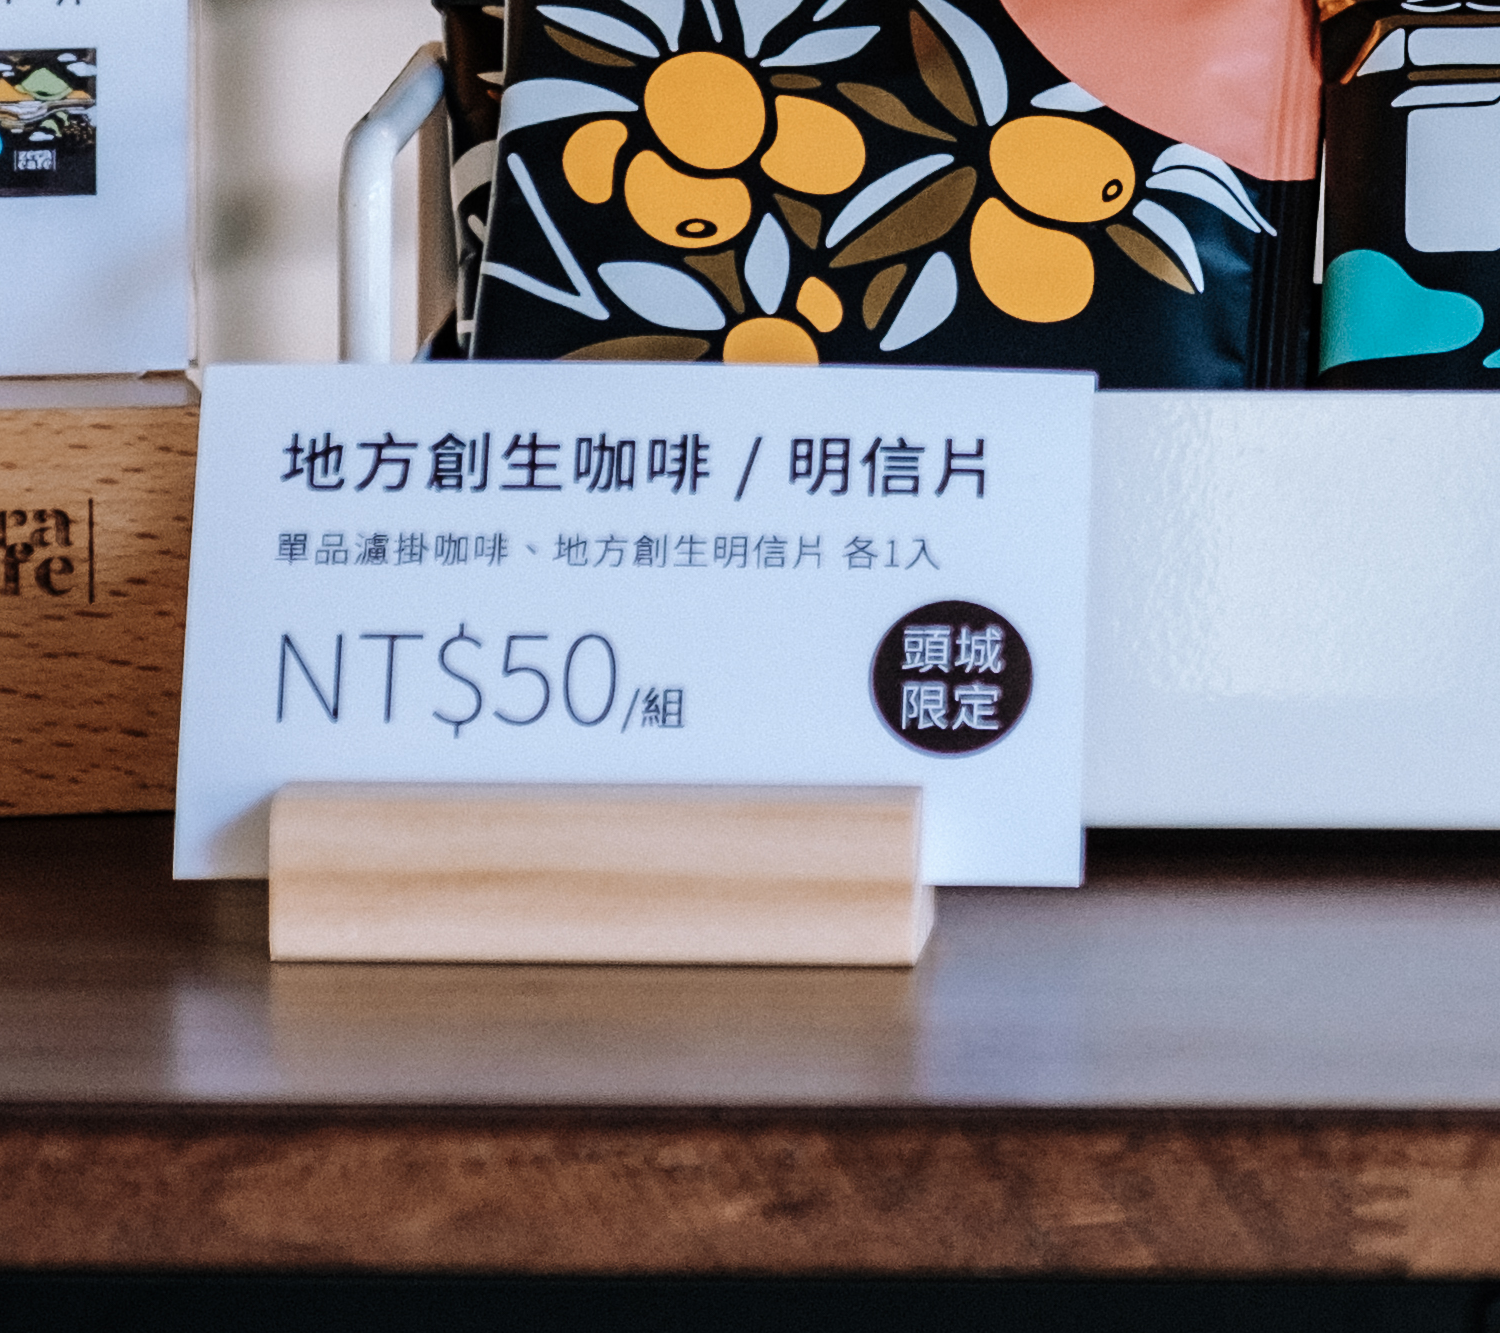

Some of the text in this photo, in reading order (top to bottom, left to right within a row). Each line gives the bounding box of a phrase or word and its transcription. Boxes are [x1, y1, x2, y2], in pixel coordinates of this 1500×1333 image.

[280, 431, 987, 501] 地方創生咖啡 / 明信片
[274, 531, 941, 571] 單品濾掛咖啡、地方創生明信片 各1入
[902, 623, 1004, 675] 頭城
[902, 681, 1000, 732] 限定
